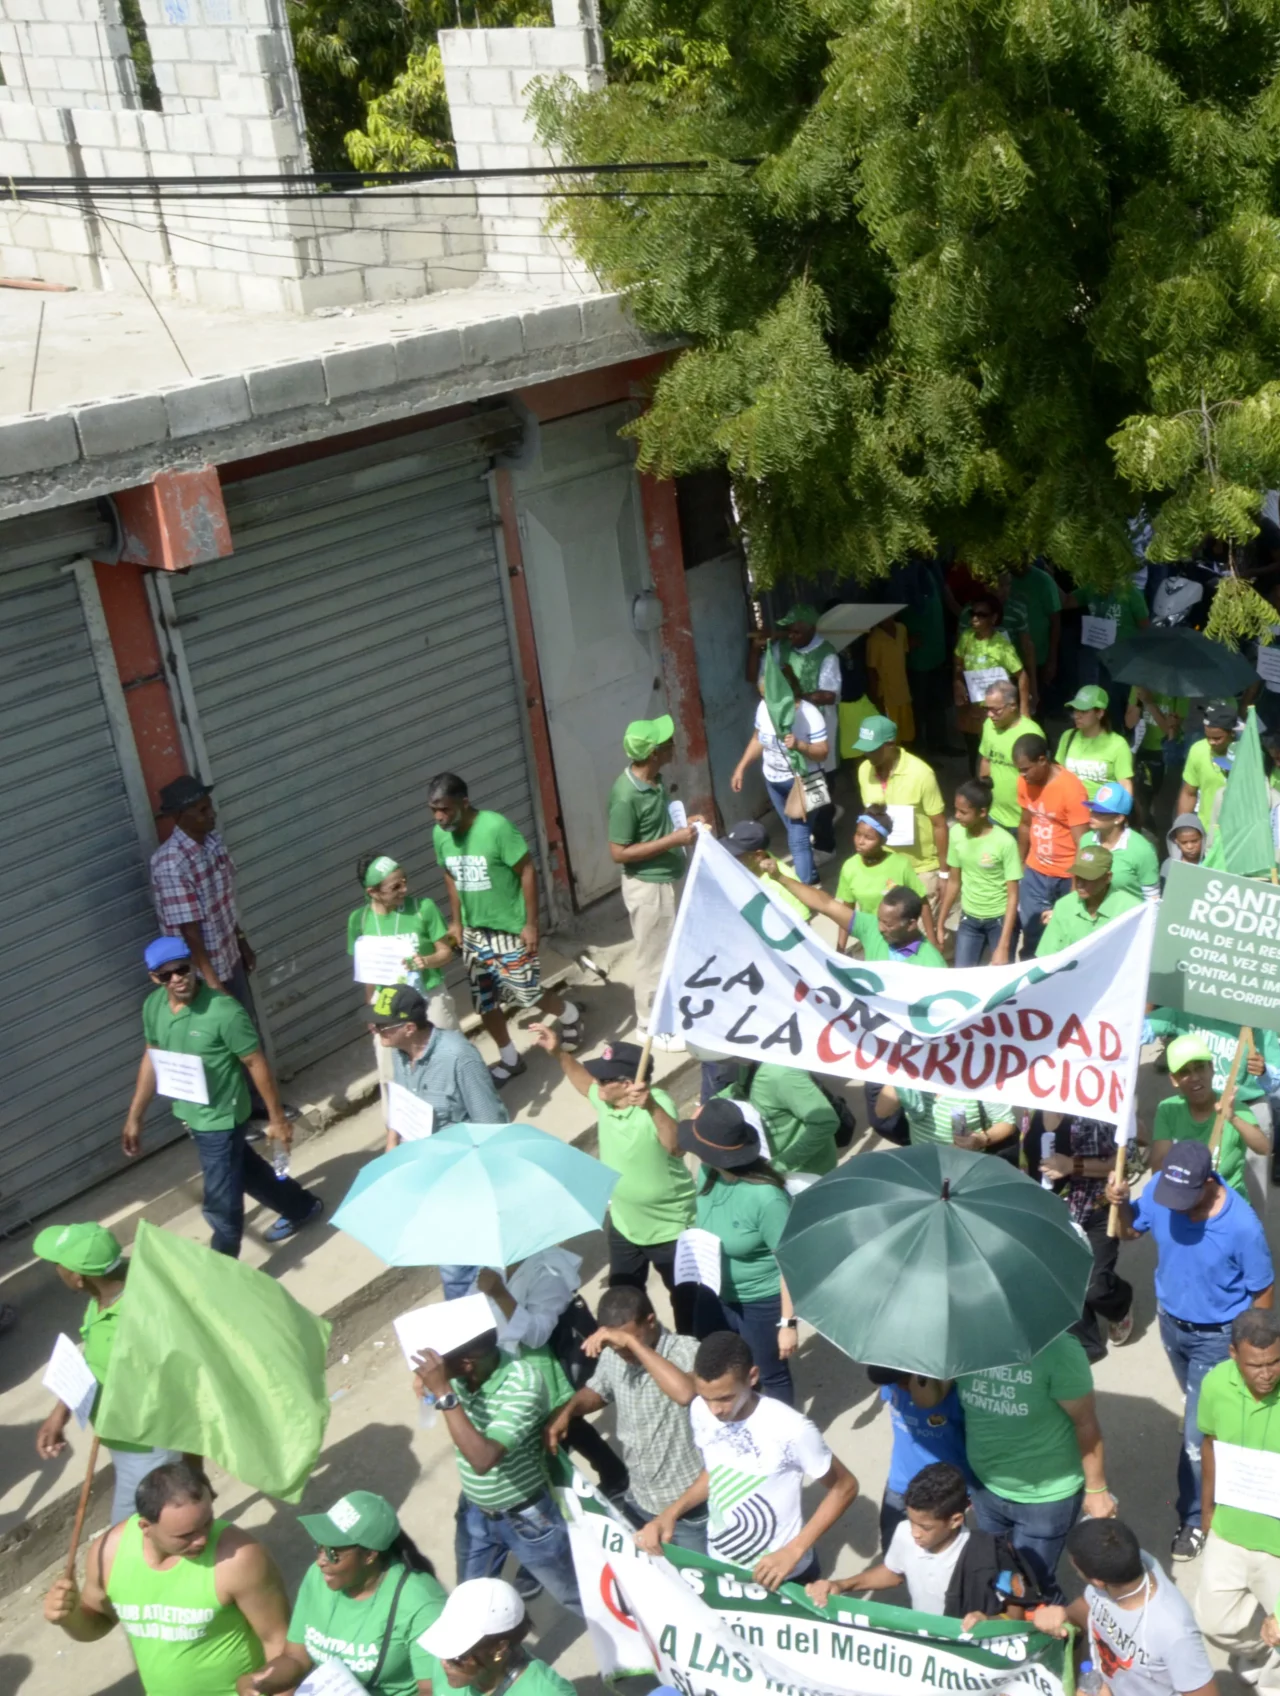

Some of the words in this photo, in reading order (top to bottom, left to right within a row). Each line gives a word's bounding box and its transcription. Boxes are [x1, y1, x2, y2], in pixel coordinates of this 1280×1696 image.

[1167, 923, 1211, 944] CUNA
[1213, 934, 1234, 949] DE
[1236, 939, 1255, 954] LA
[684, 955, 765, 996] LA
[1177, 960, 1238, 985] CONTRA
[1240, 974, 1260, 989] LA
[1189, 946, 1228, 966] OTRA
[1232, 956, 1258, 973] VEZ
[1260, 962, 1279, 976] SE
[1187, 979, 1198, 991] Y
[1198, 982, 1218, 997] LA
[678, 995, 715, 1030] Y
[725, 1005, 803, 1056] LA
[961, 1389, 1029, 1417] MONTAÑAS
[971, 1379, 988, 1395] DE
[992, 1383, 1016, 1400] LAS
[602, 1524, 625, 1553] la
[143, 1604, 214, 1624] ATLETISMO
[358, 1642, 380, 1657] LA
[659, 1624, 678, 1662] A
[688, 1632, 753, 1683] LAS
[777, 1623, 818, 1655] del
[831, 1631, 912, 1679] Medio
